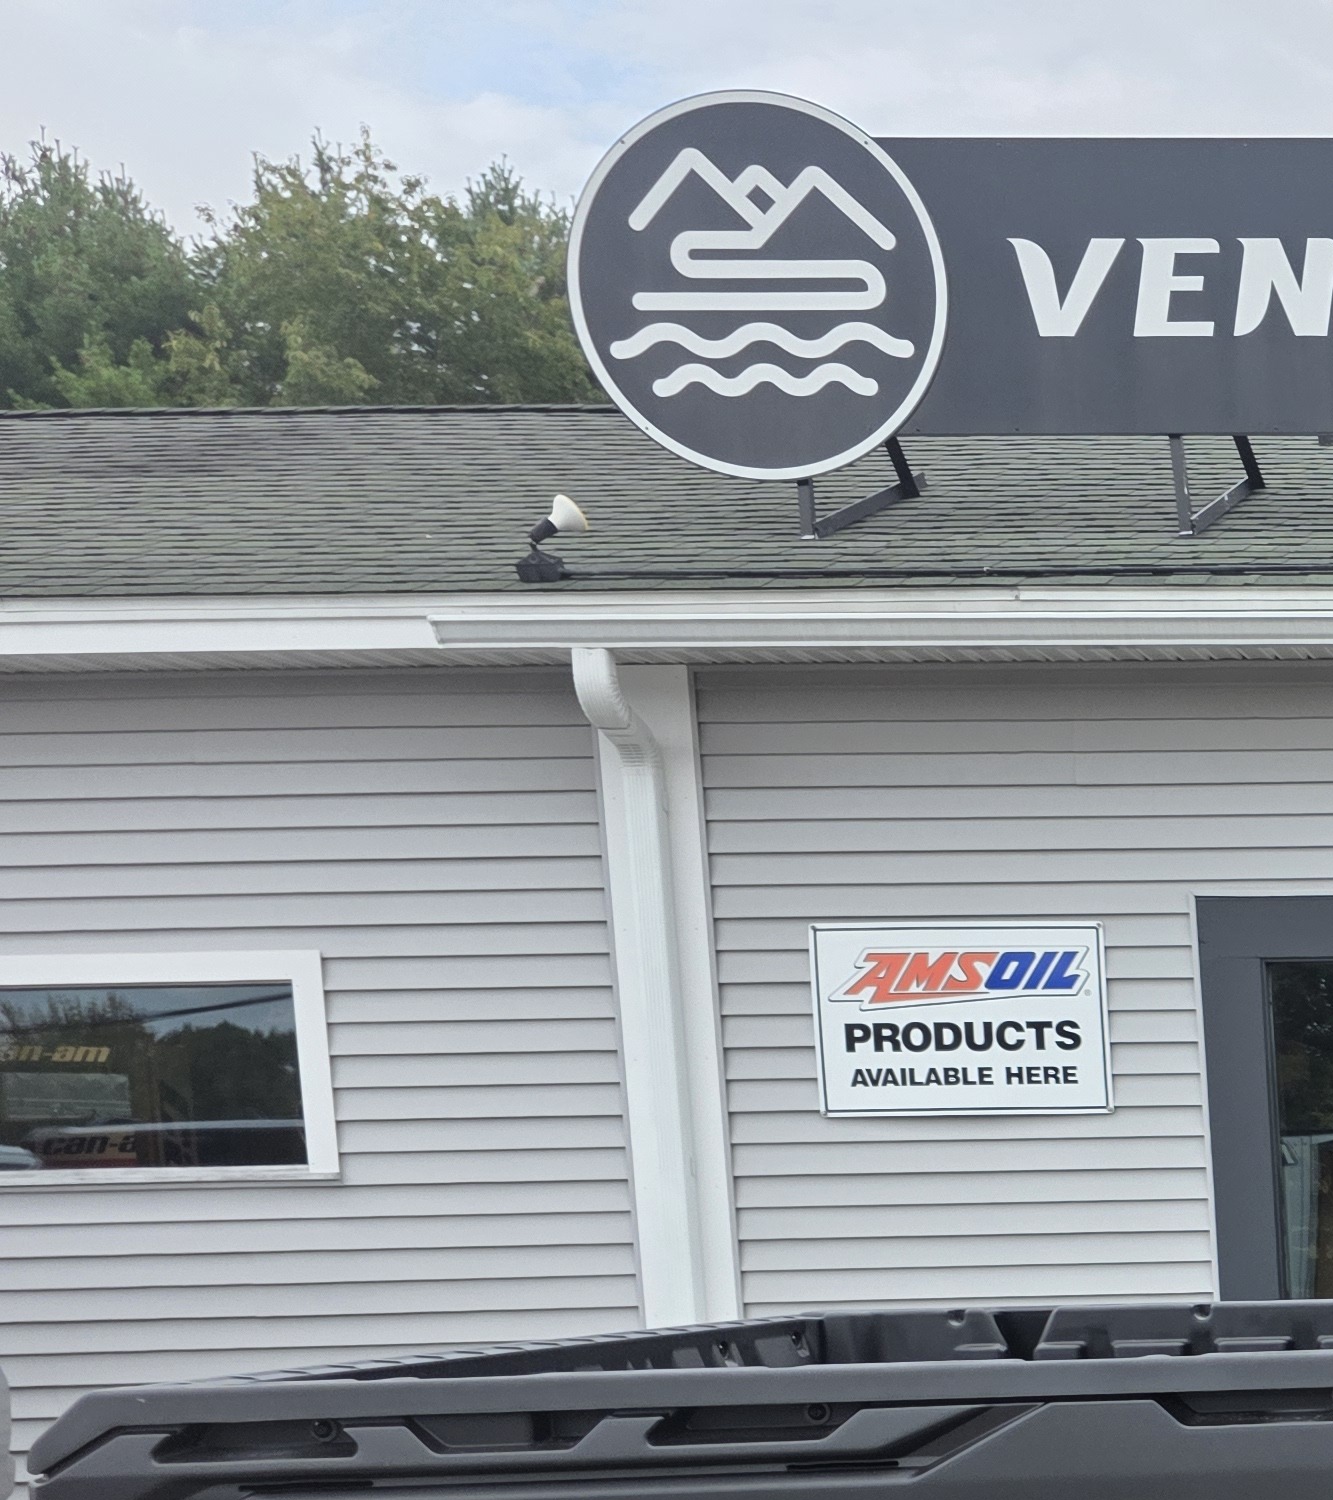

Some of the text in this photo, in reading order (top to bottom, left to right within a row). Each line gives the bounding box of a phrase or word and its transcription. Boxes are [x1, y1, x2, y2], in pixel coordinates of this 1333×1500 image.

[843, 951, 1080, 1004] AMSOIL
[844, 1020, 1082, 1053] PRODUCTS
[851, 1065, 1079, 1088] AVAILABLE HERE
[43, 1135, 137, 1154] can-a
